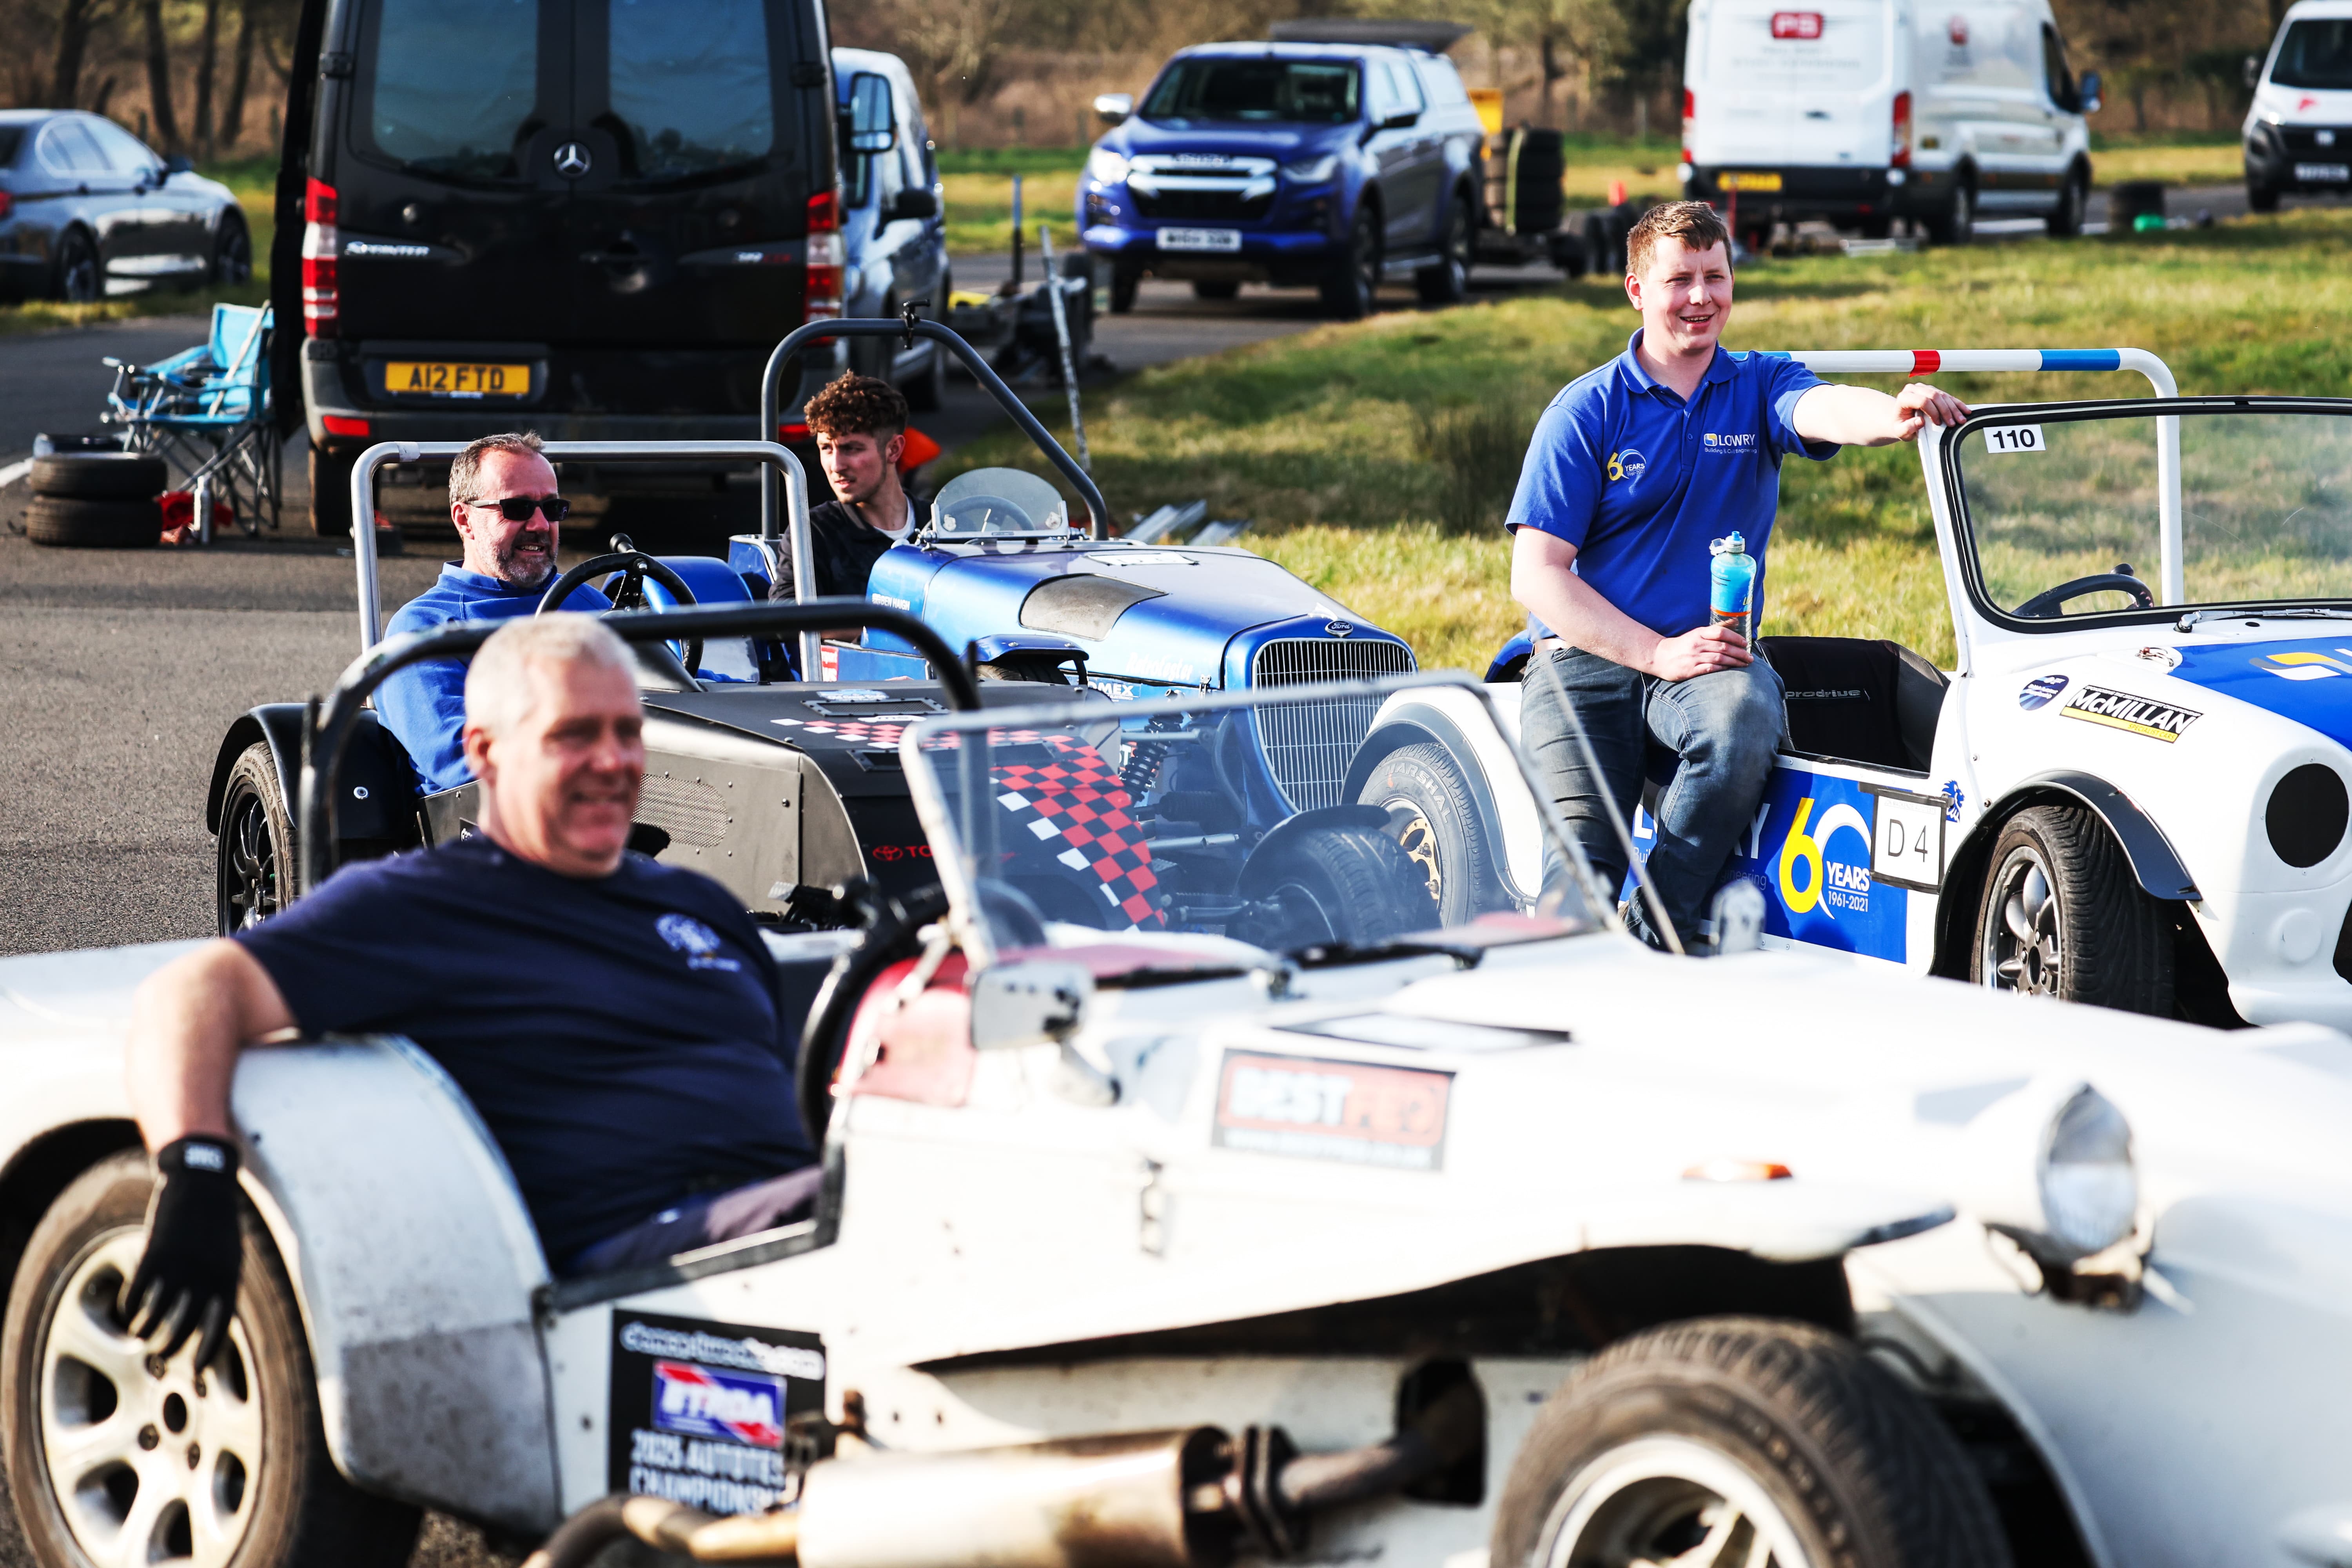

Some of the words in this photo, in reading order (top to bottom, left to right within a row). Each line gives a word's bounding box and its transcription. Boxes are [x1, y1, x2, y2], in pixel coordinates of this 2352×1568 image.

[409, 365, 448, 389] A12
[455, 366, 505, 390] FTD
[1719, 434, 1755, 446] LOWRY
[1993, 429, 2035, 448] 110
[1625, 463, 1645, 472] YEARS
[1785, 689, 1861, 700] prodrive
[2066, 689, 2196, 734] McMILLAN
[2129, 723, 2160, 736] SPECIALIST
[2159, 732, 2176, 740] CARS
[1384, 762, 1451, 824] MARSHAL
[1888, 818, 1905, 857] D
[1914, 825, 1928, 863] 4
[1826, 860, 1870, 892] YEARS
[1828, 891, 1869, 913] 1961-2021
